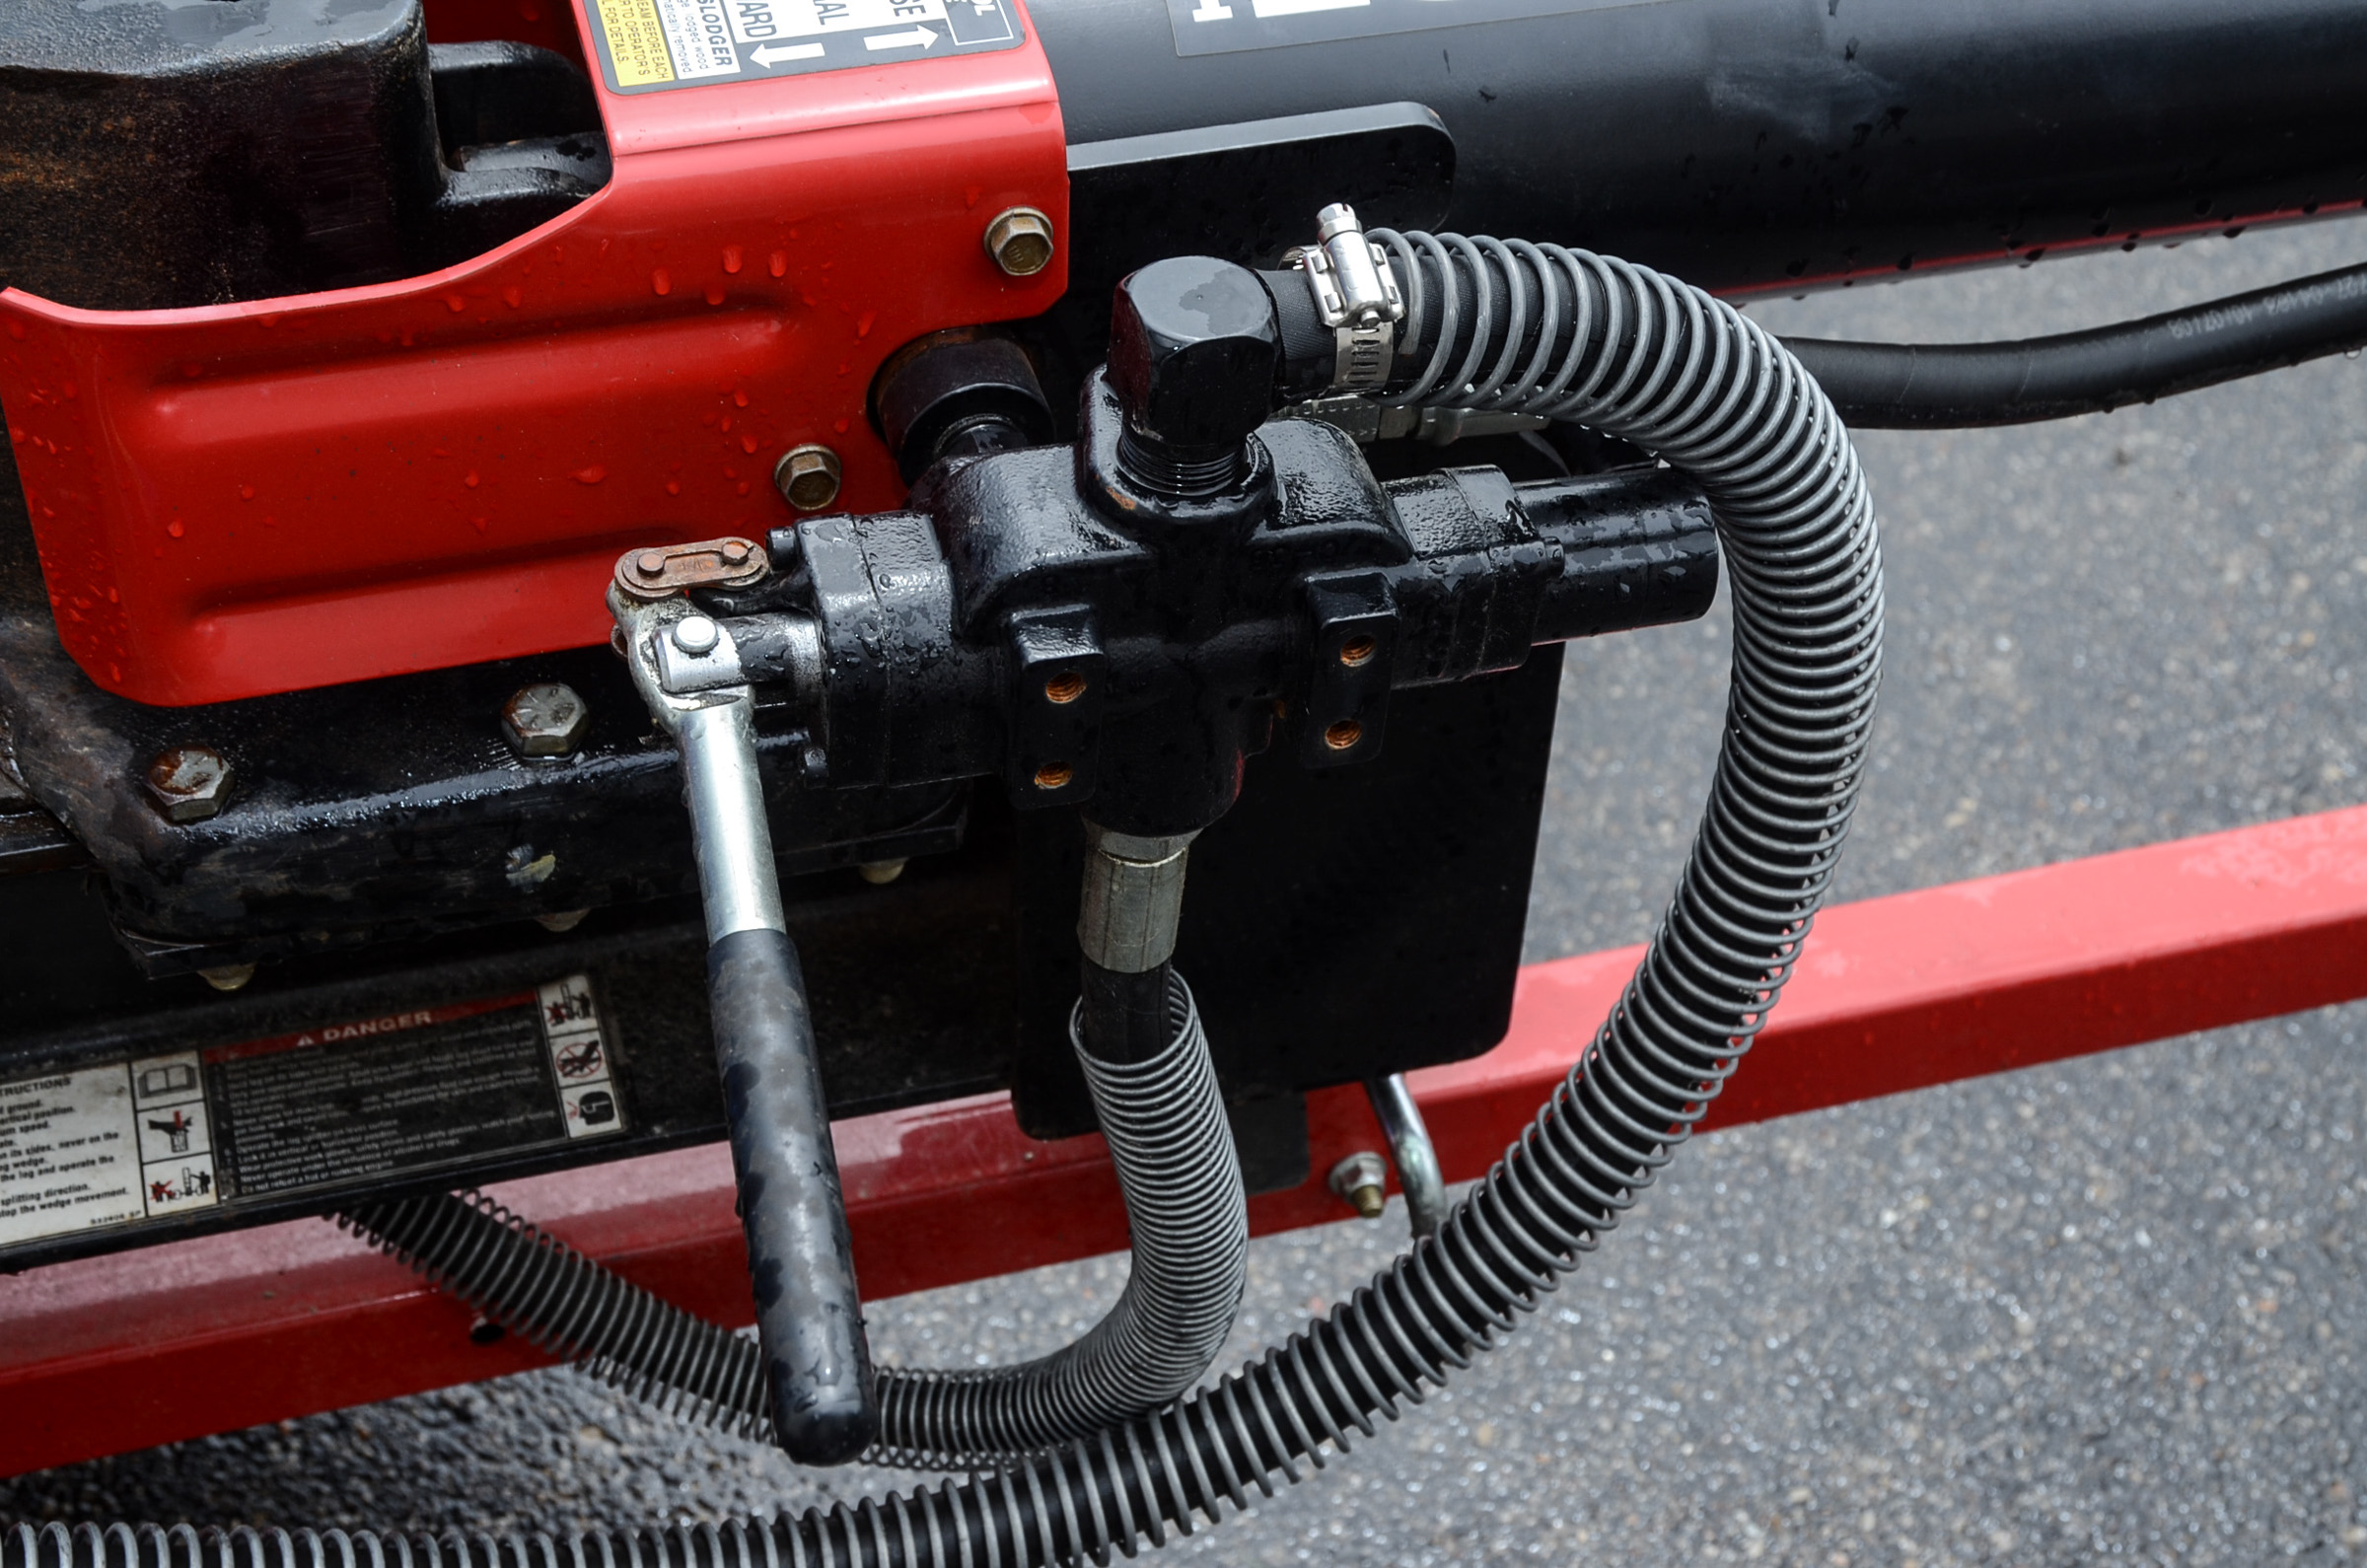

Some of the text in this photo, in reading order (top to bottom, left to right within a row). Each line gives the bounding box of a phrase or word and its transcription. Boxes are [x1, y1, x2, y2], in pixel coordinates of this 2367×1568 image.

[605, 8, 619, 25] FOR
[621, 8, 635, 20] TO
[609, 26, 629, 64] DETAILS.
[625, 20, 651, 76] OPERATOR'S
[642, 21, 662, 54] BEFORE
[652, 56, 671, 79] EACH
[684, 13, 702, 43] lodged
[694, 45, 712, 70] wood
[322, 1011, 432, 1040] DANGER
[6, 1100, 42, 1114] ground.
[34, 1105, 77, 1119] position.
[19, 1119, 51, 1133] speed.
[57, 1138, 86, 1149] never
[88, 1135, 101, 1144] on
[102, 1129, 119, 1140] the
[12, 1155, 48, 1170] wedge.
[18, 1169, 35, 1179] log
[36, 1165, 55, 1176] and
[57, 1158, 96, 1173] operate
[98, 1153, 115, 1164] the
[0, 1180, 91, 1207] splitting direction.
[20, 1204, 35, 1214] the
[38, 1197, 71, 1211] wedge
[73, 1185, 130, 1205] movement.
